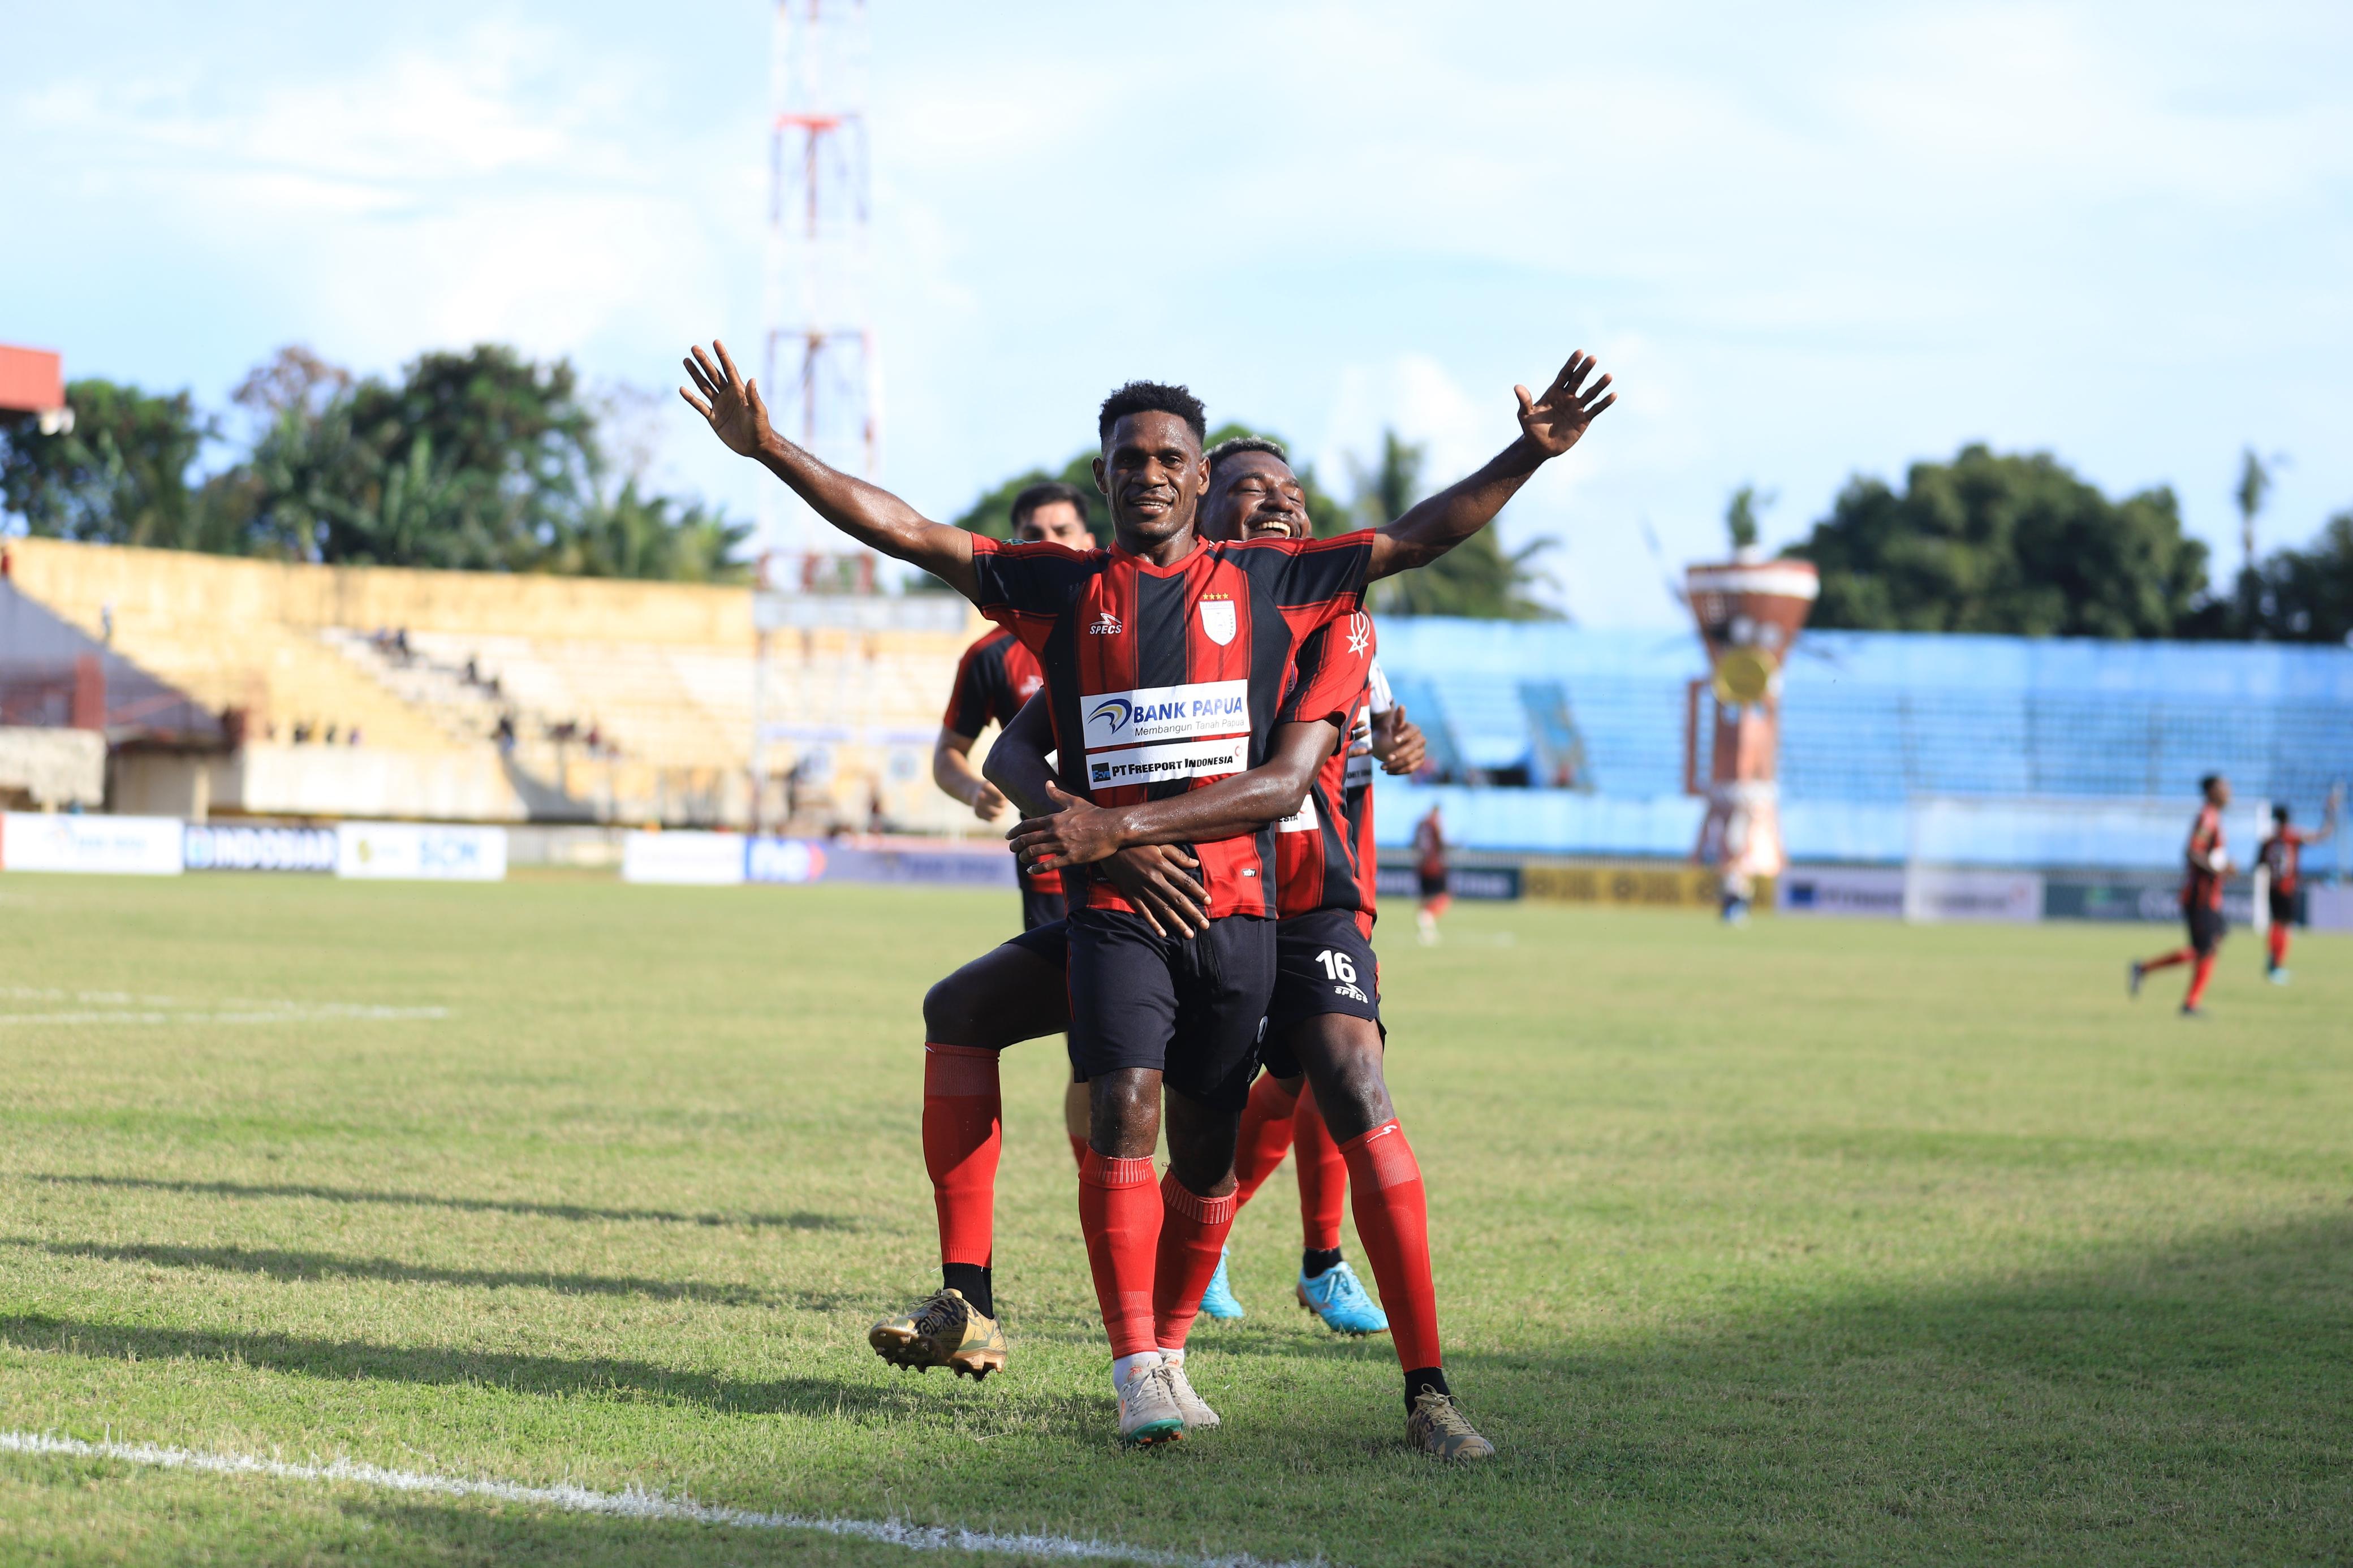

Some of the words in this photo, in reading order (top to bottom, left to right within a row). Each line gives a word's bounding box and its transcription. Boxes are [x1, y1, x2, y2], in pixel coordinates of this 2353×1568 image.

[1089, 624, 1122, 634] SPECS
[1134, 701, 1187, 723] BANK
[1192, 697, 1243, 716] PAPUA
[1135, 724, 1192, 737] Membangun
[1196, 721, 1219, 730] Tanah
[1222, 719, 1244, 729] Papua
[1111, 765, 1127, 777] PT
[1128, 761, 1183, 775] FREEPORT
[1184, 755, 1233, 768] INDONESIA
[1315, 950, 1357, 983] 16
[1334, 987, 1369, 1004] SPECS
